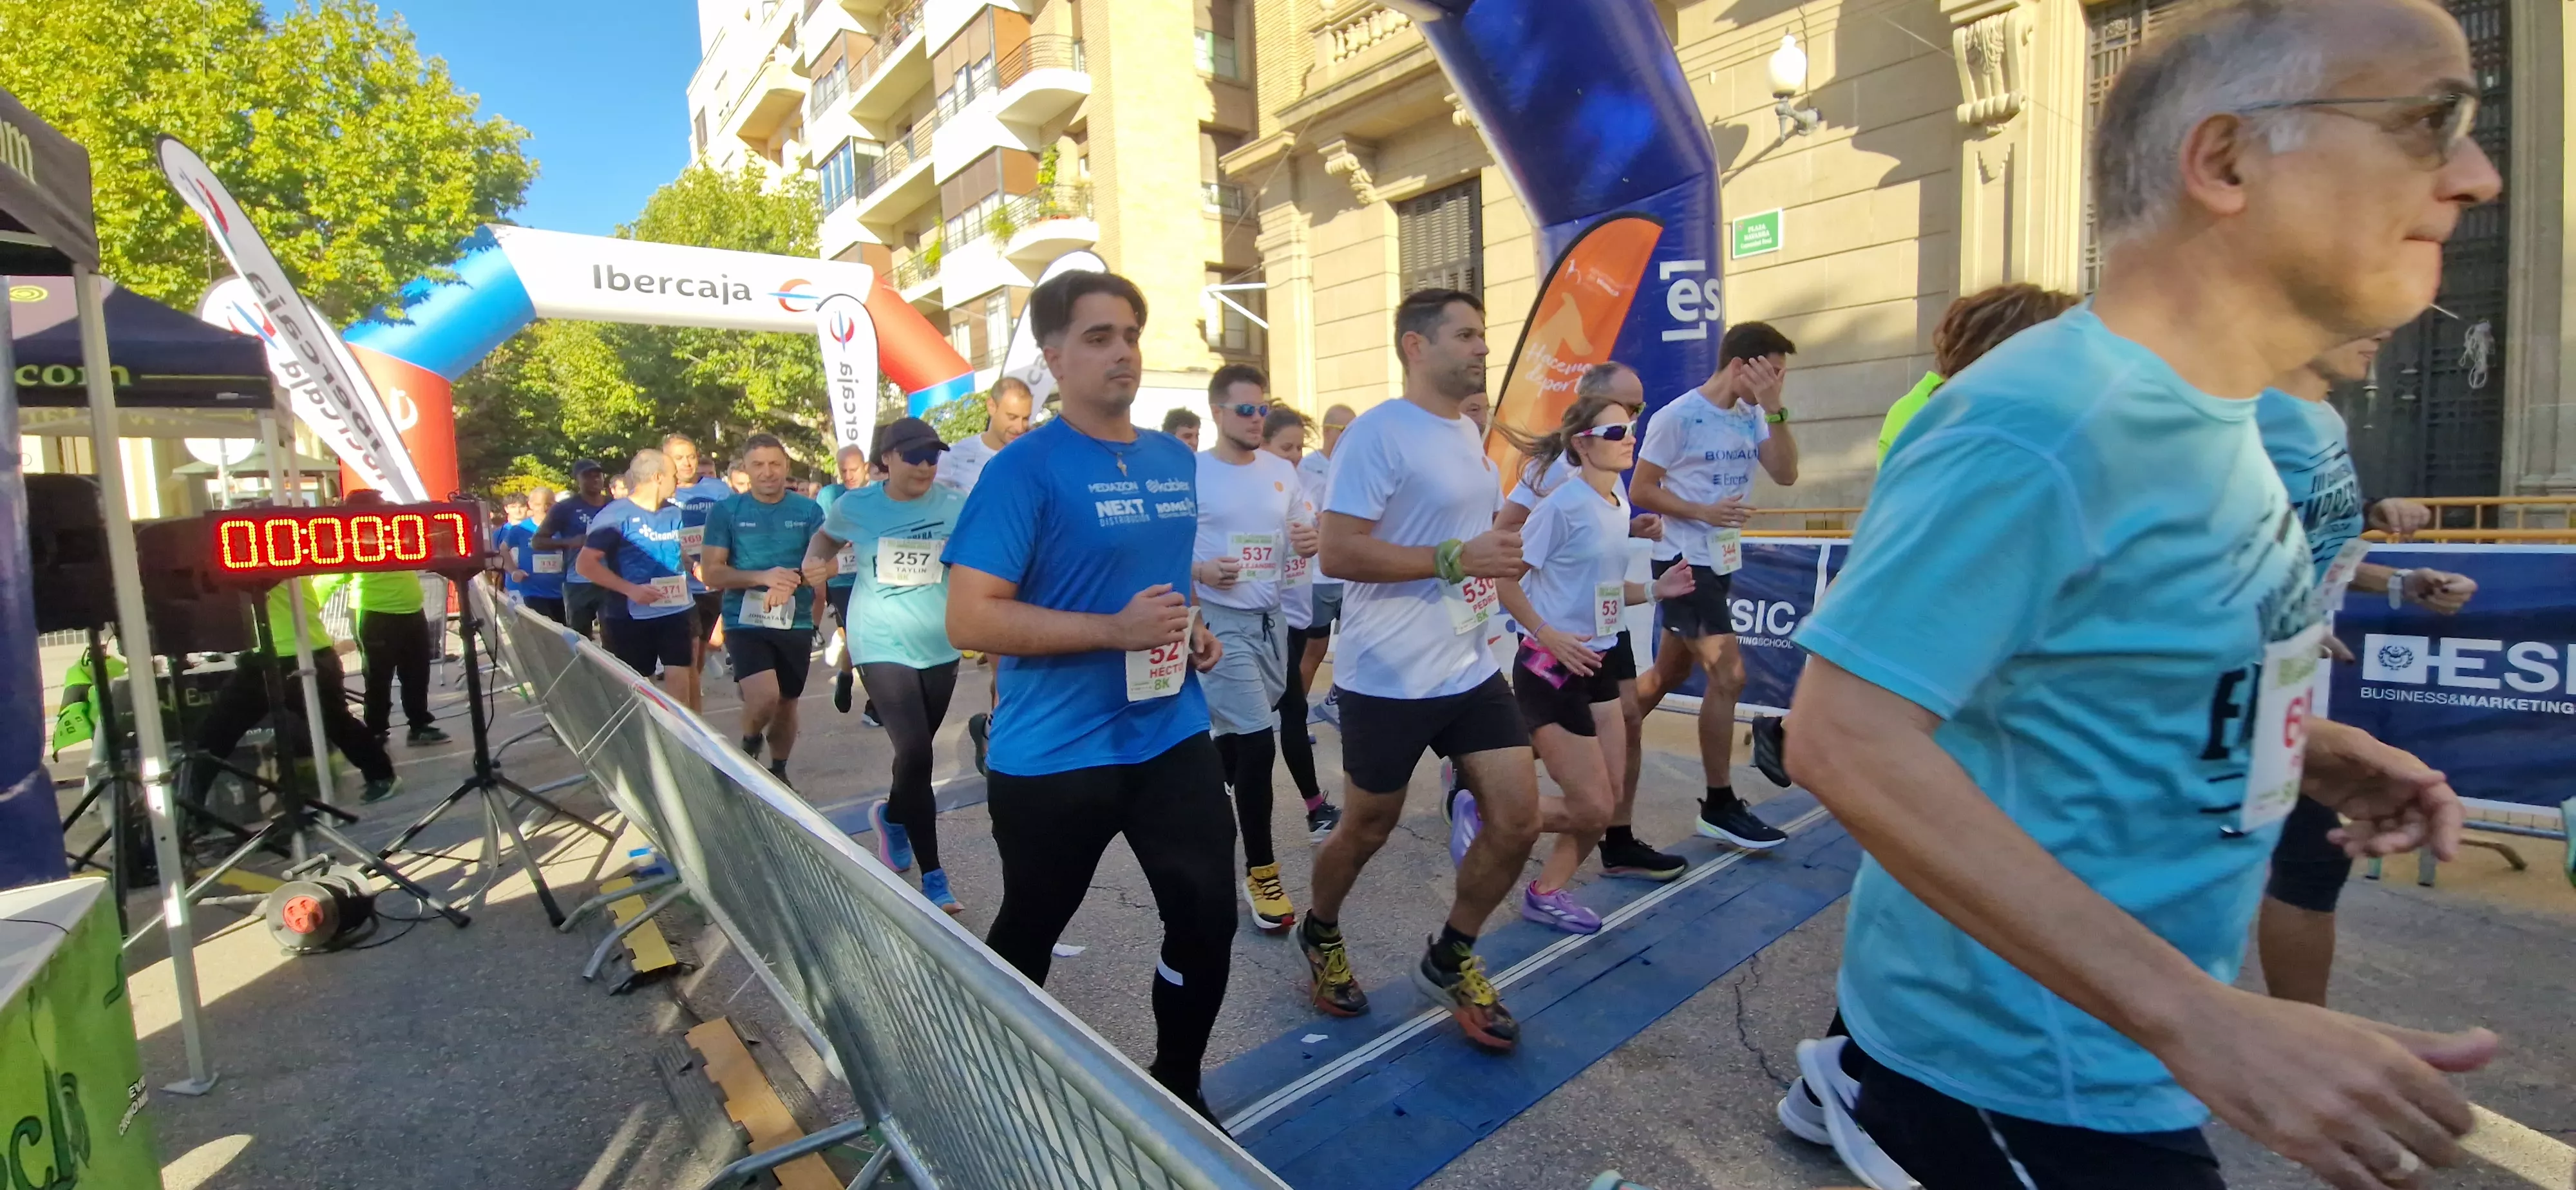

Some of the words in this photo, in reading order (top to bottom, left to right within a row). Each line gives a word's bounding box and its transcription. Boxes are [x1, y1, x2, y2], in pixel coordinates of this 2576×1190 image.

[593, 264, 752, 305] Ibercaja
[1095, 499, 1144, 518] NEXT
[220, 513, 469, 569] 00:00:07
[1242, 547, 1273, 561] 537
[1721, 542, 1737, 557] 344
[893, 551, 931, 566] 257
[661, 585, 681, 594] 371
[1476, 608, 1489, 622] 8K
[1726, 598, 1795, 636] SIC
[1154, 678, 1170, 691] 8K
